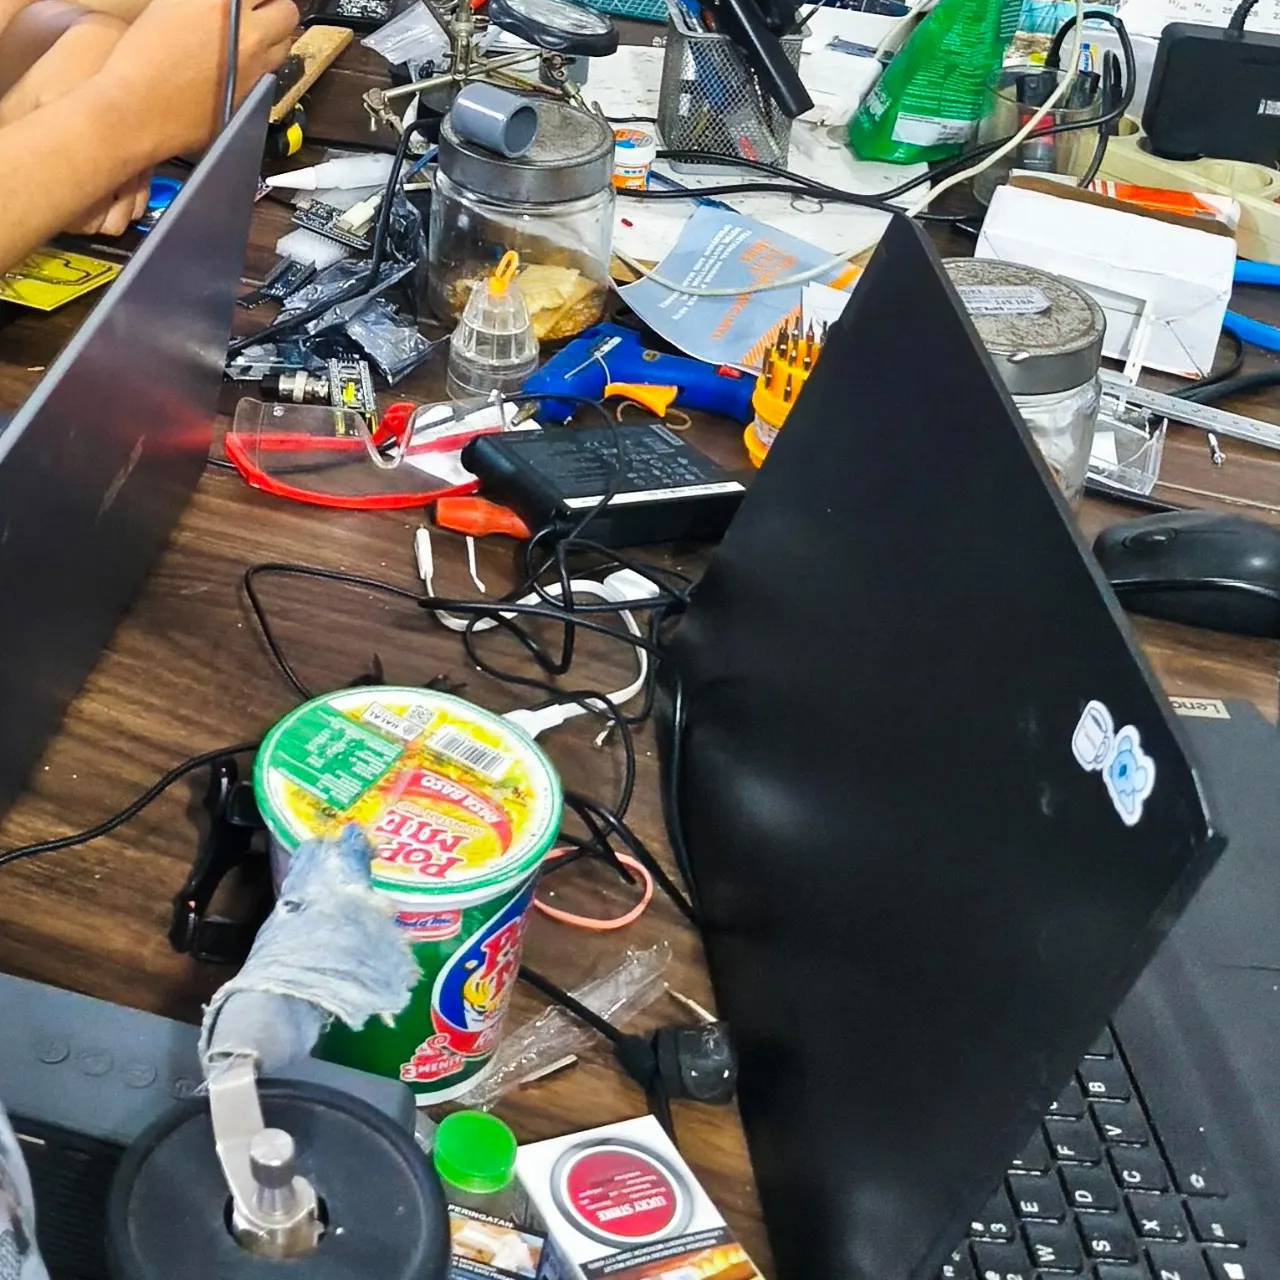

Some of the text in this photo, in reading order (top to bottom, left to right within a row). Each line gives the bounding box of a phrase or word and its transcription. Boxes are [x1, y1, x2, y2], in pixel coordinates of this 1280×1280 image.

[369, 710, 400, 730] HALAL
[420, 775, 503, 824] RASA BASO
[374, 810, 469, 854] MIE
[375, 842, 465, 879] POP
[595, 1195, 668, 1222] LUCKY STRIKE
